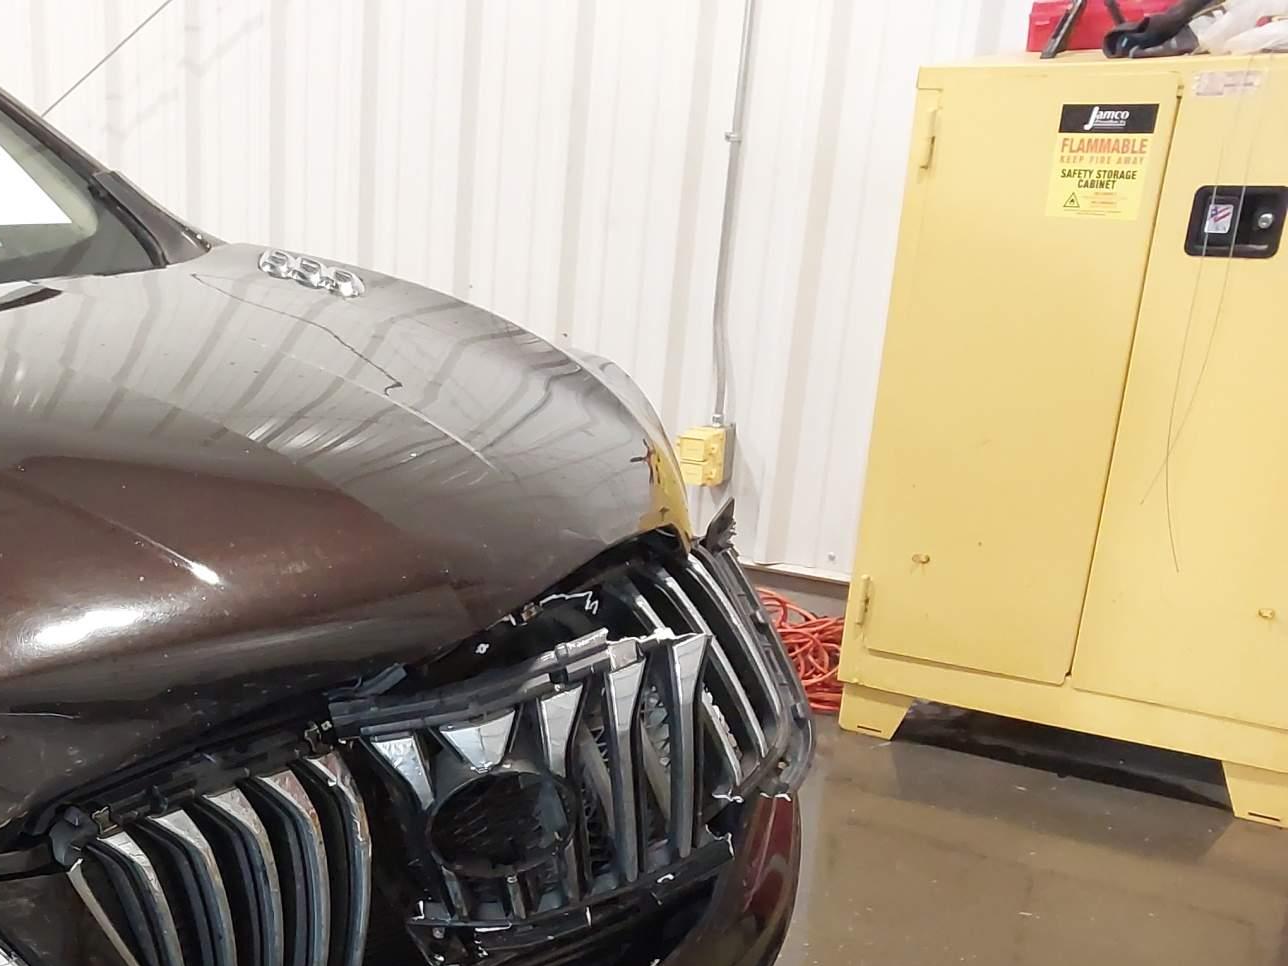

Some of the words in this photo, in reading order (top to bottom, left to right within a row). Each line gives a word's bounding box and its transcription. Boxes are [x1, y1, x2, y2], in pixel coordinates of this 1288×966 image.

[1083, 106, 1130, 130] Jamco
[1061, 138, 1148, 154] FLAMMABLE
[1117, 156, 1144, 165] AWAY
[1060, 168, 1094, 179] SAFETY
[1096, 169, 1137, 180] STORAGE
[1078, 180, 1117, 189] CABINET
